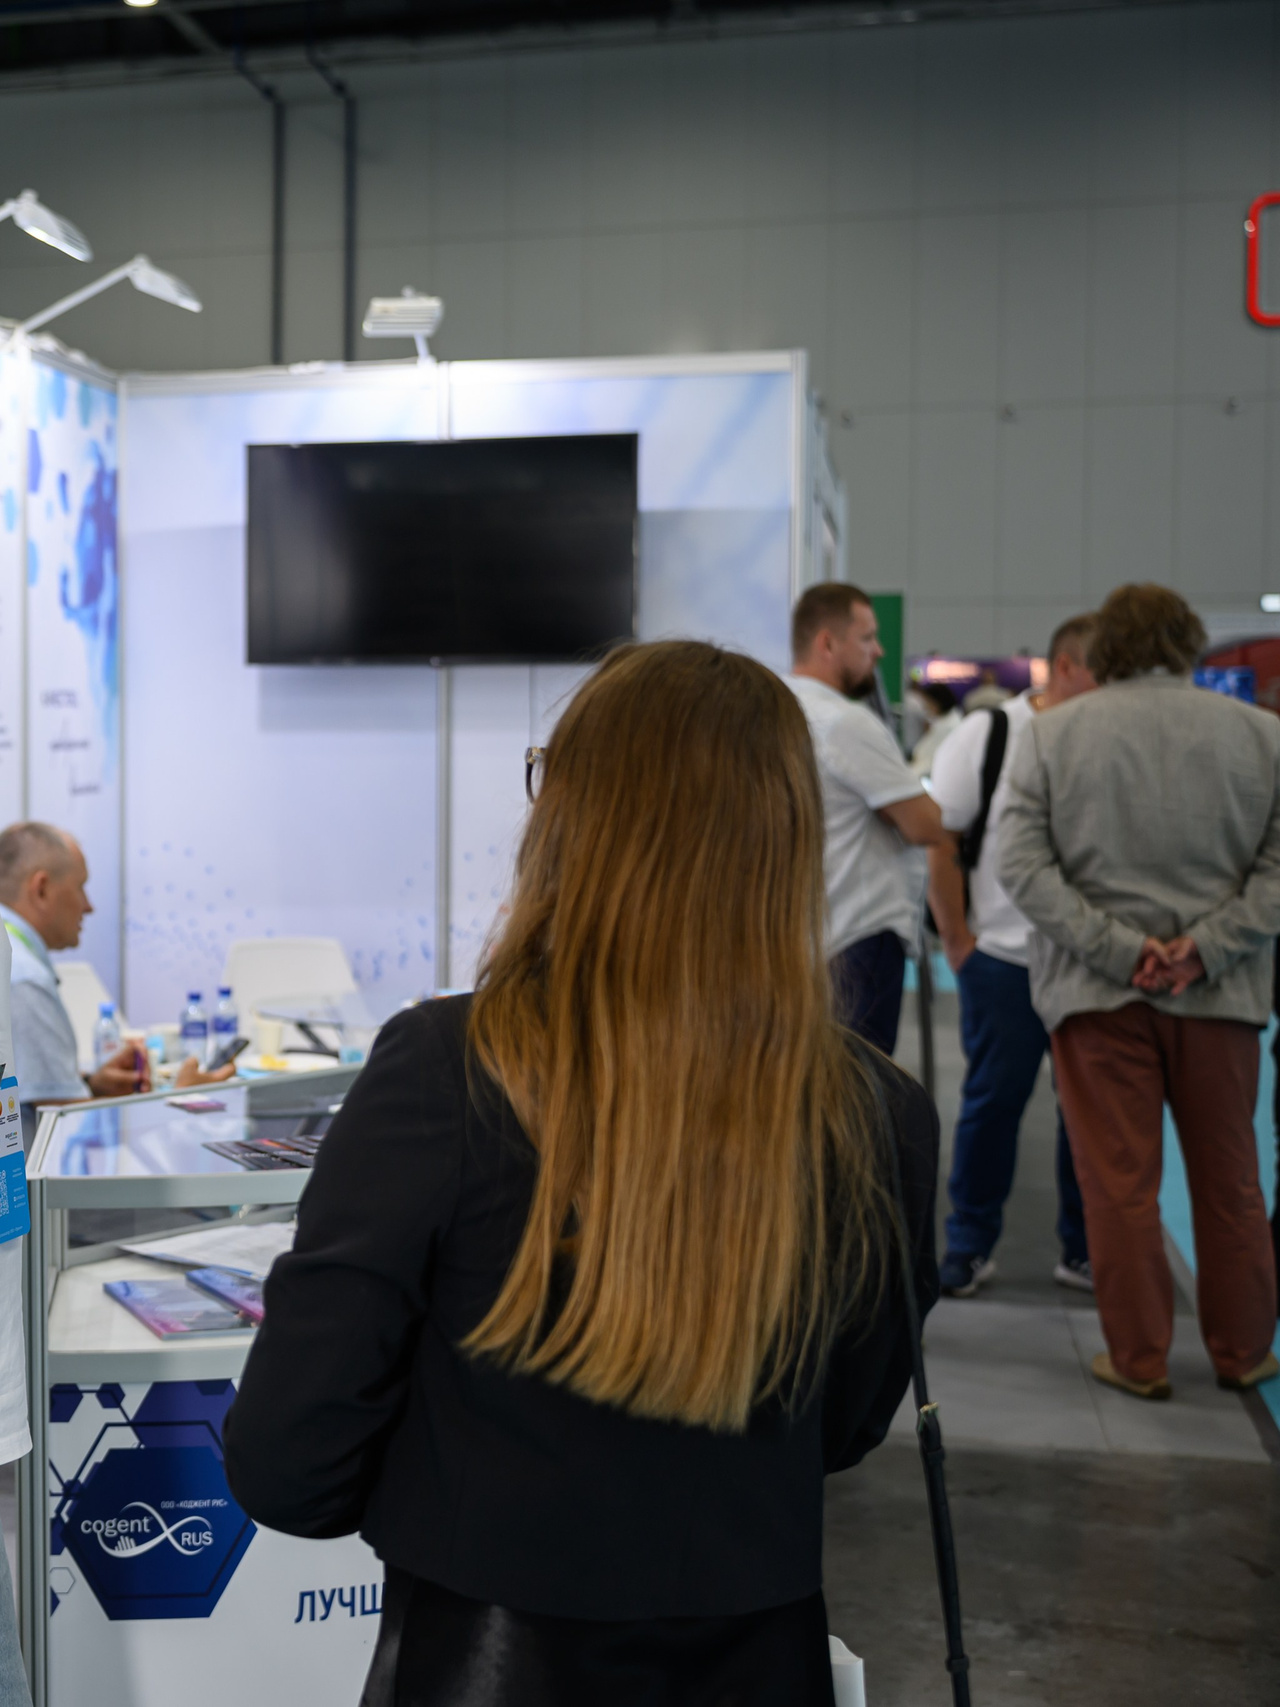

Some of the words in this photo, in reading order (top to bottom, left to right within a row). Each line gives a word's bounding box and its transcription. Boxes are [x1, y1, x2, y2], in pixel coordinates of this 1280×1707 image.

[160, 1500, 175, 1509] ООО
[80, 1515, 152, 1538] cogent
[181, 1530, 214, 1547] RUS
[294, 1582, 383, 1624] ЛУЧШ
